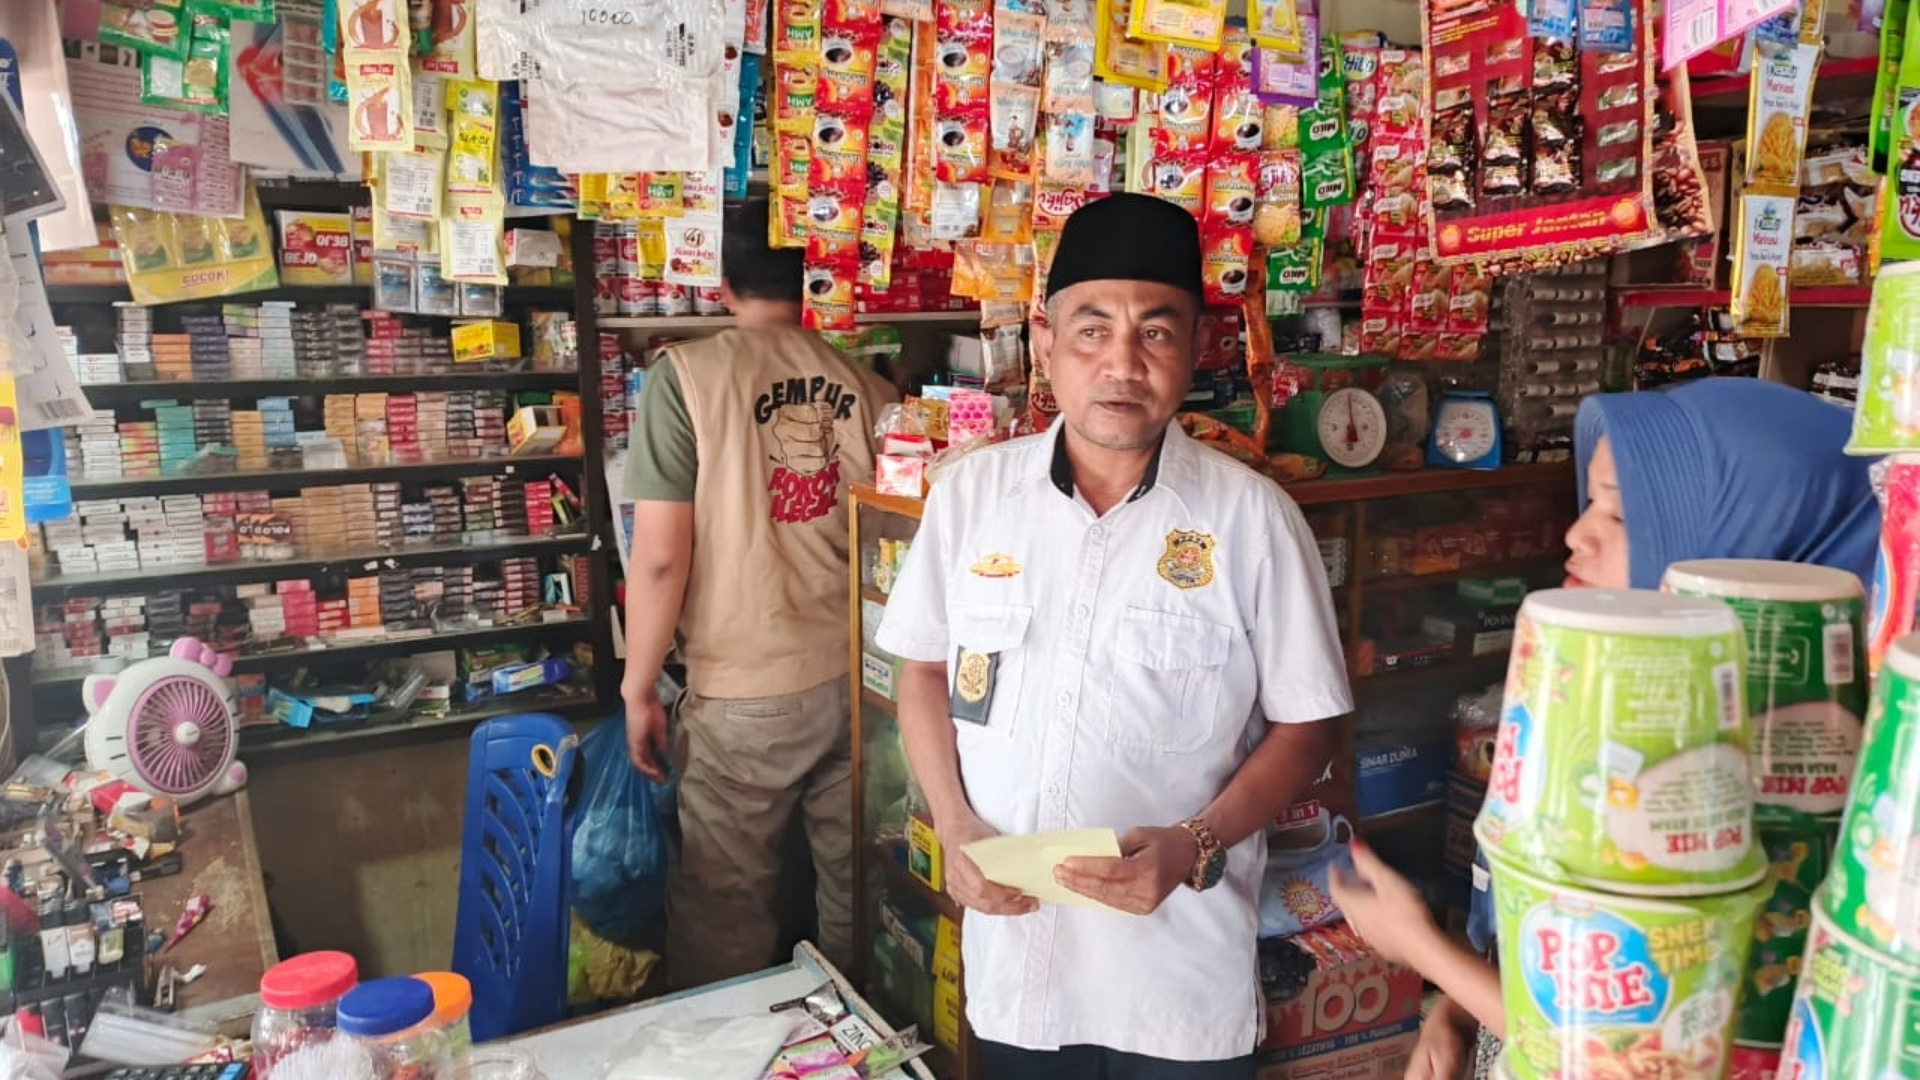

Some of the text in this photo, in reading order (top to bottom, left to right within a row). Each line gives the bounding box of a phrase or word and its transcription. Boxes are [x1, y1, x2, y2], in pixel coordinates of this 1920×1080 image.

[1312, 121, 1337, 135] MILO
[1318, 181, 1343, 196] MILO
[316, 235, 349, 247] BEJO
[1466, 221, 1527, 244] Super
[284, 253, 317, 265] BEJO
[1283, 269, 1307, 281] MILO
[754, 375, 856, 425] GEMPUR
[1810, 775, 1846, 795] POP
[1536, 928, 1618, 972] POP
[1301, 972, 1389, 1037] 100
